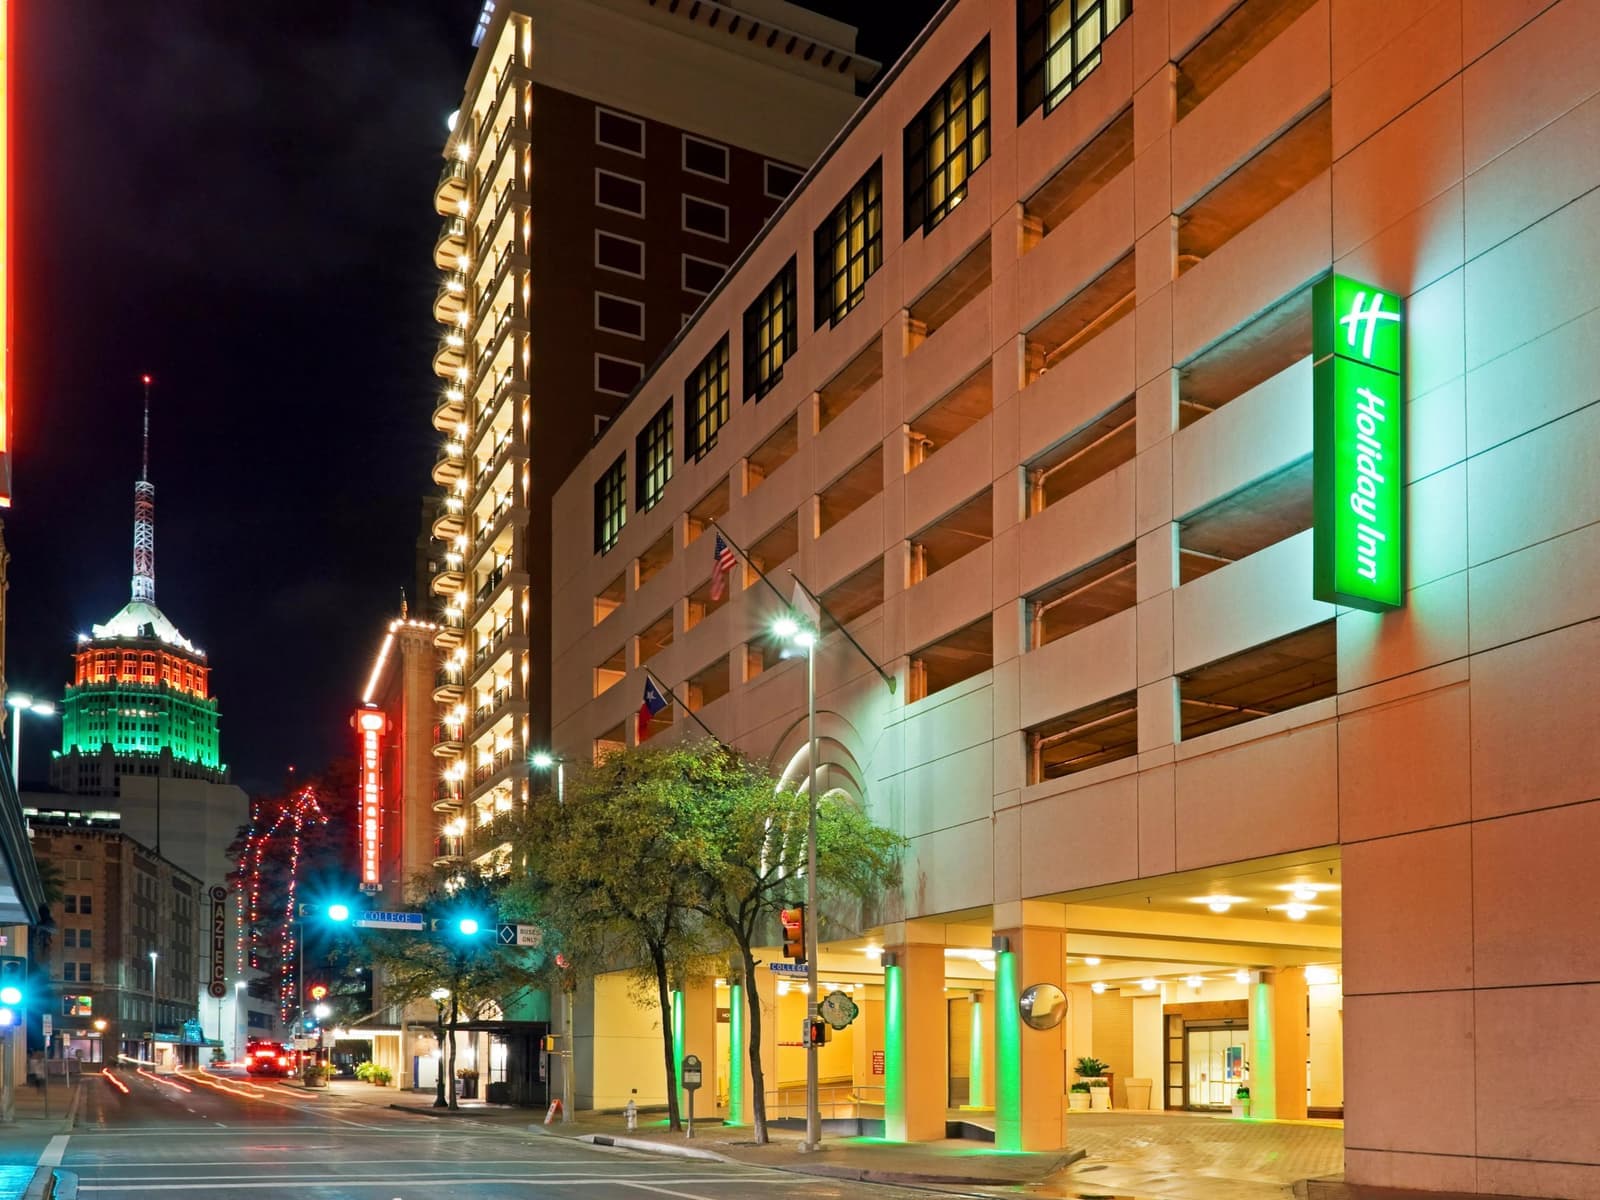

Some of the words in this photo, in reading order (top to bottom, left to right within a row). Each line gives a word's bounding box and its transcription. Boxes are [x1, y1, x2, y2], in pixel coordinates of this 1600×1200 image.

[1350, 386, 1386, 523] Holiday
[1356, 522, 1386, 579] Inn
[215, 904, 225, 979] AZTEC
[363, 911, 410, 922] COLLEGE
[771, 963, 806, 972] COLLEGE
